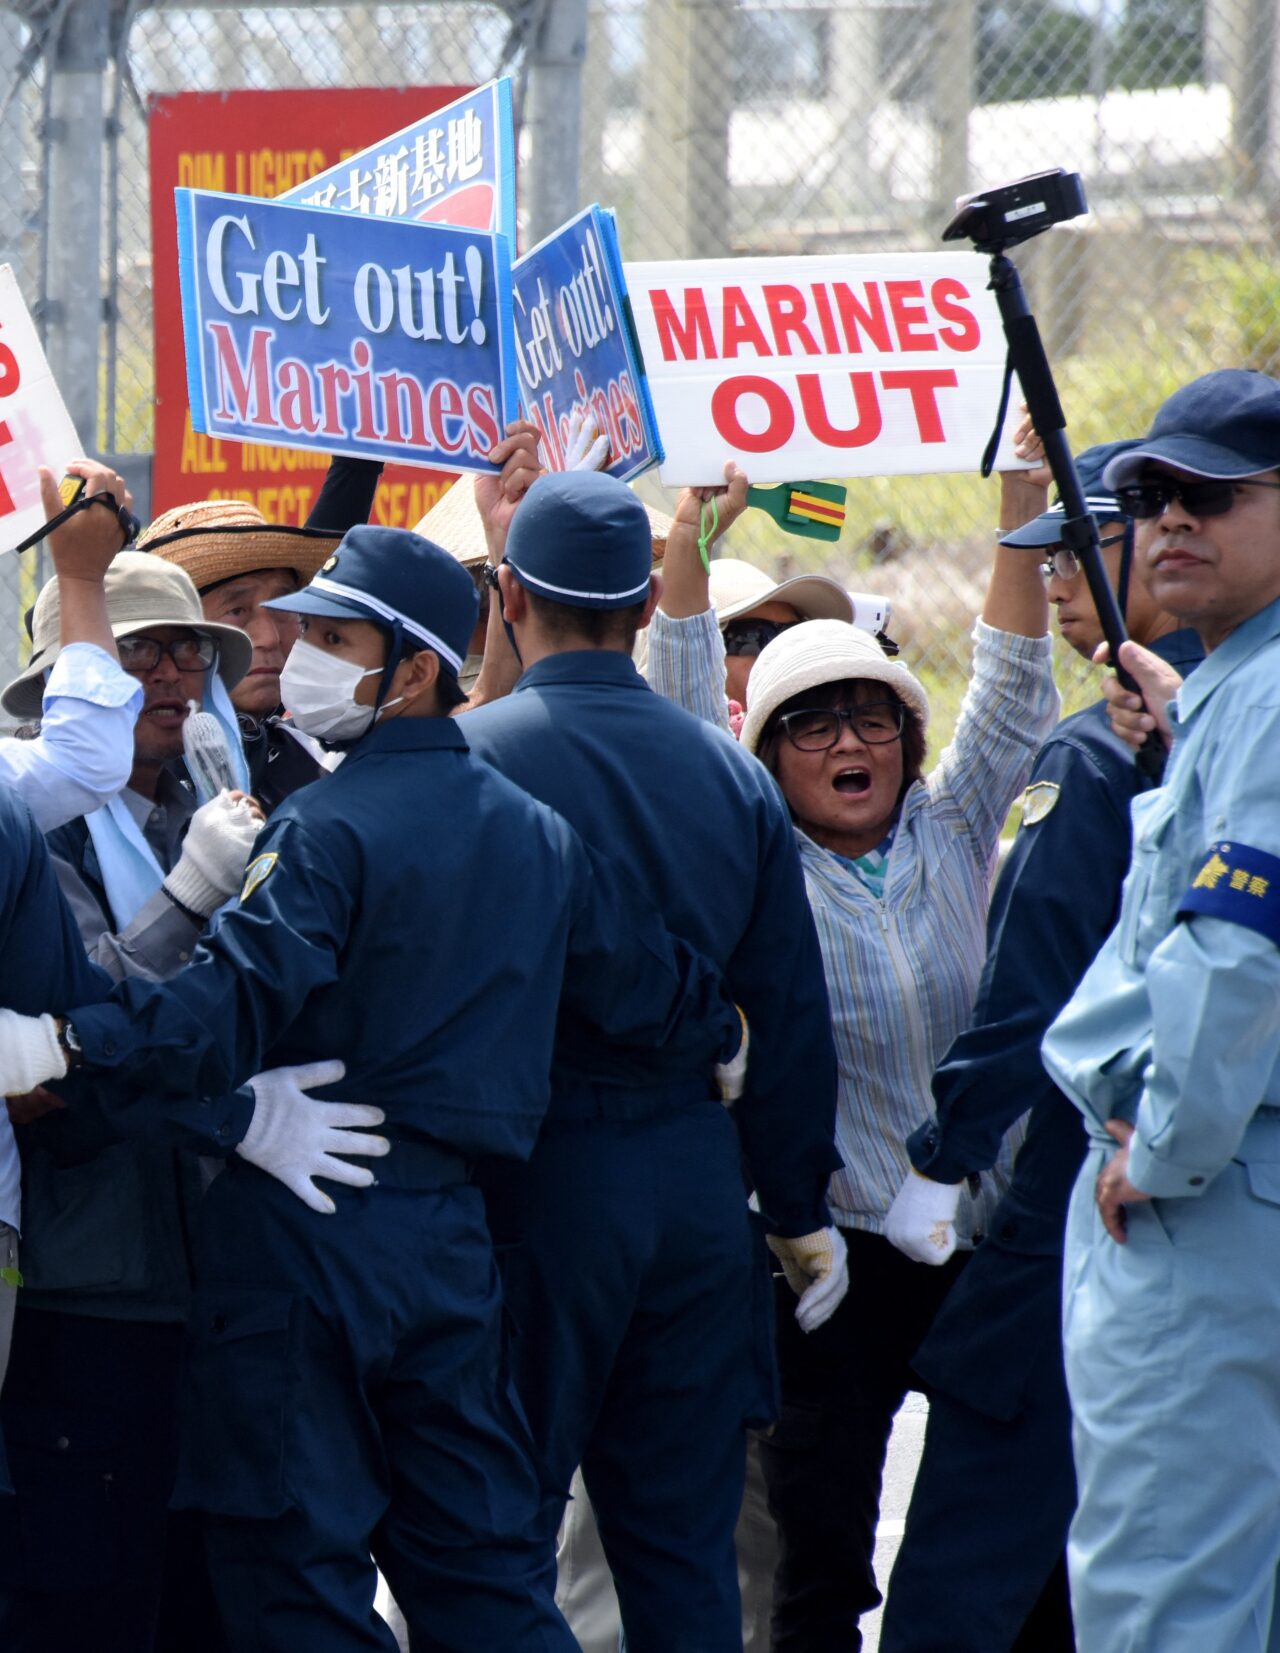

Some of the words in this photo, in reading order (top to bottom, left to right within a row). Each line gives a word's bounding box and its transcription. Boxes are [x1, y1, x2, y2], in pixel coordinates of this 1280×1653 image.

[206, 214, 329, 326] Get
[354, 244, 486, 347] out!
[512, 277, 562, 390] Get
[560, 228, 614, 358] out!
[648, 277, 981, 362] MARINES
[207, 322, 498, 456] Marines
[711, 368, 959, 453] OUT
[1229, 868, 1270, 898] 警察
